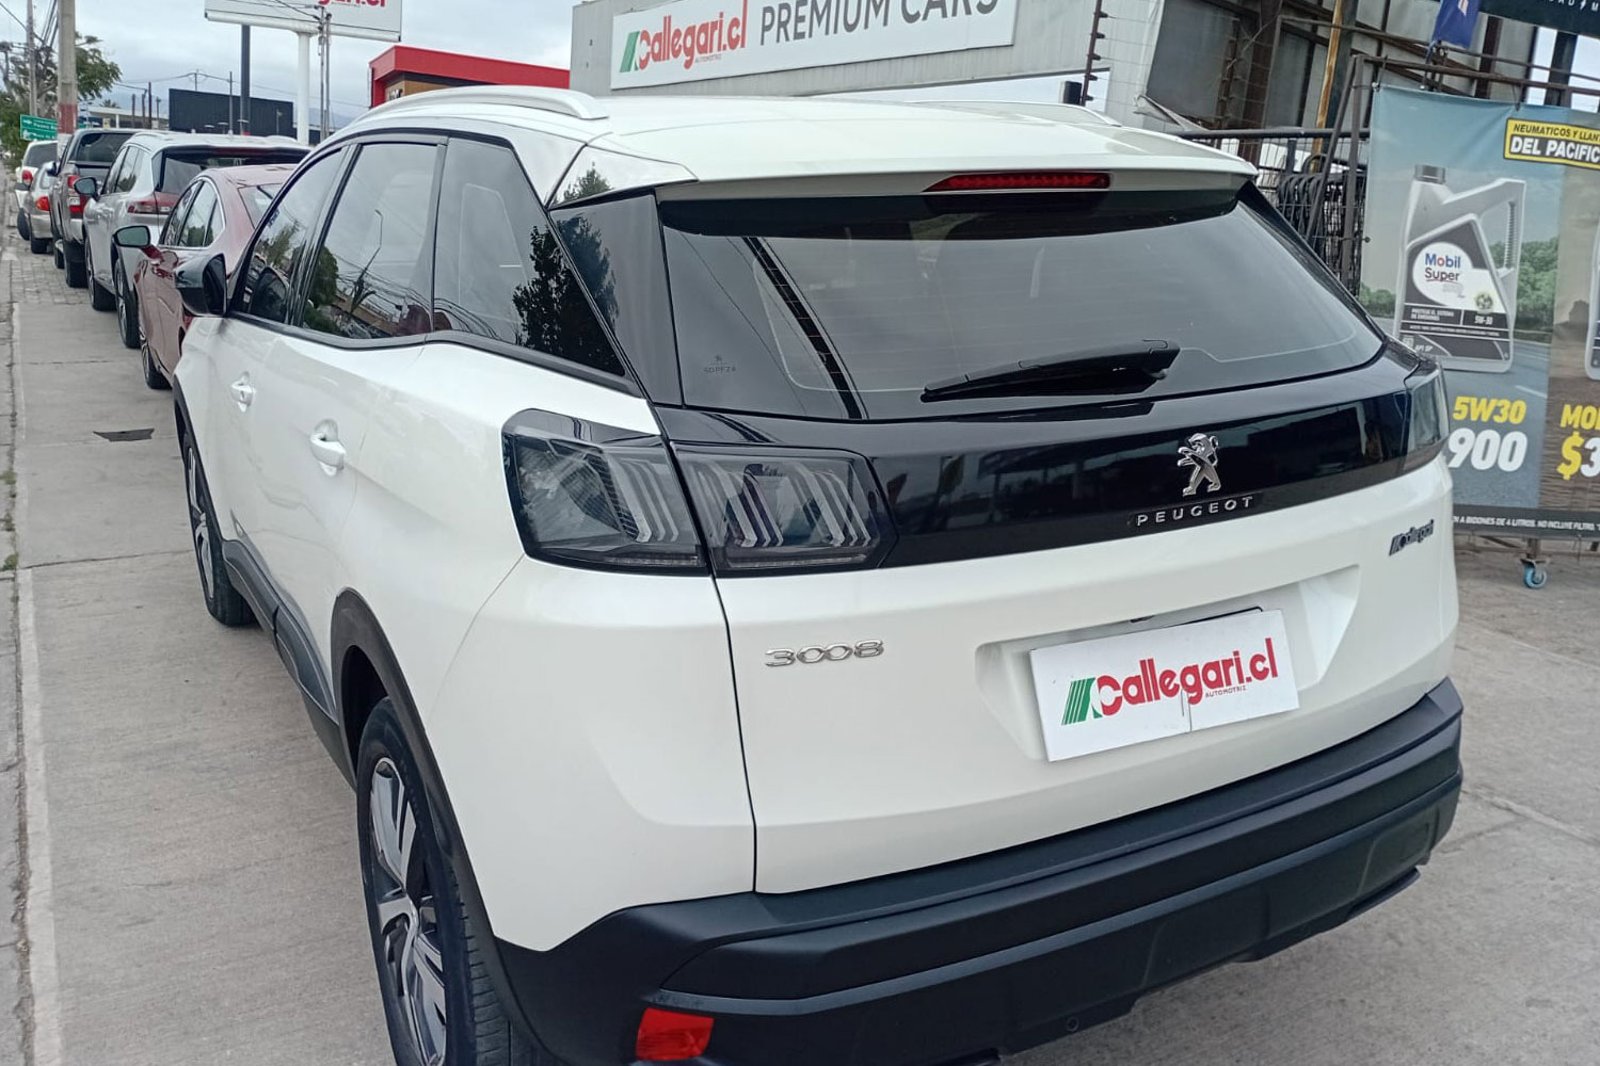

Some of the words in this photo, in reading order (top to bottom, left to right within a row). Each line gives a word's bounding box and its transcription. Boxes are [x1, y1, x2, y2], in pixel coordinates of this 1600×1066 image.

[639, 0, 748, 70] Callegari.cl
[760, 0, 889, 46] PREMIUM
[1514, 124, 1571, 137] NEUMATICOS
[1580, 131, 1600, 141] LLAN
[1511, 136, 1541, 155] DEL
[1545, 140, 1600, 163] PACIFIC
[1425, 253, 1461, 269] Mobil
[1425, 267, 1460, 282] Super
[1453, 396, 1527, 424] 5W30
[1448, 428, 1527, 472] 900
[1137, 496, 1253, 527] PEUGEOT
[765, 639, 884, 667] 3008
[1095, 637, 1279, 717] Callegari.cl
[1205, 686, 1248, 698] AUTOMOTRIZ
